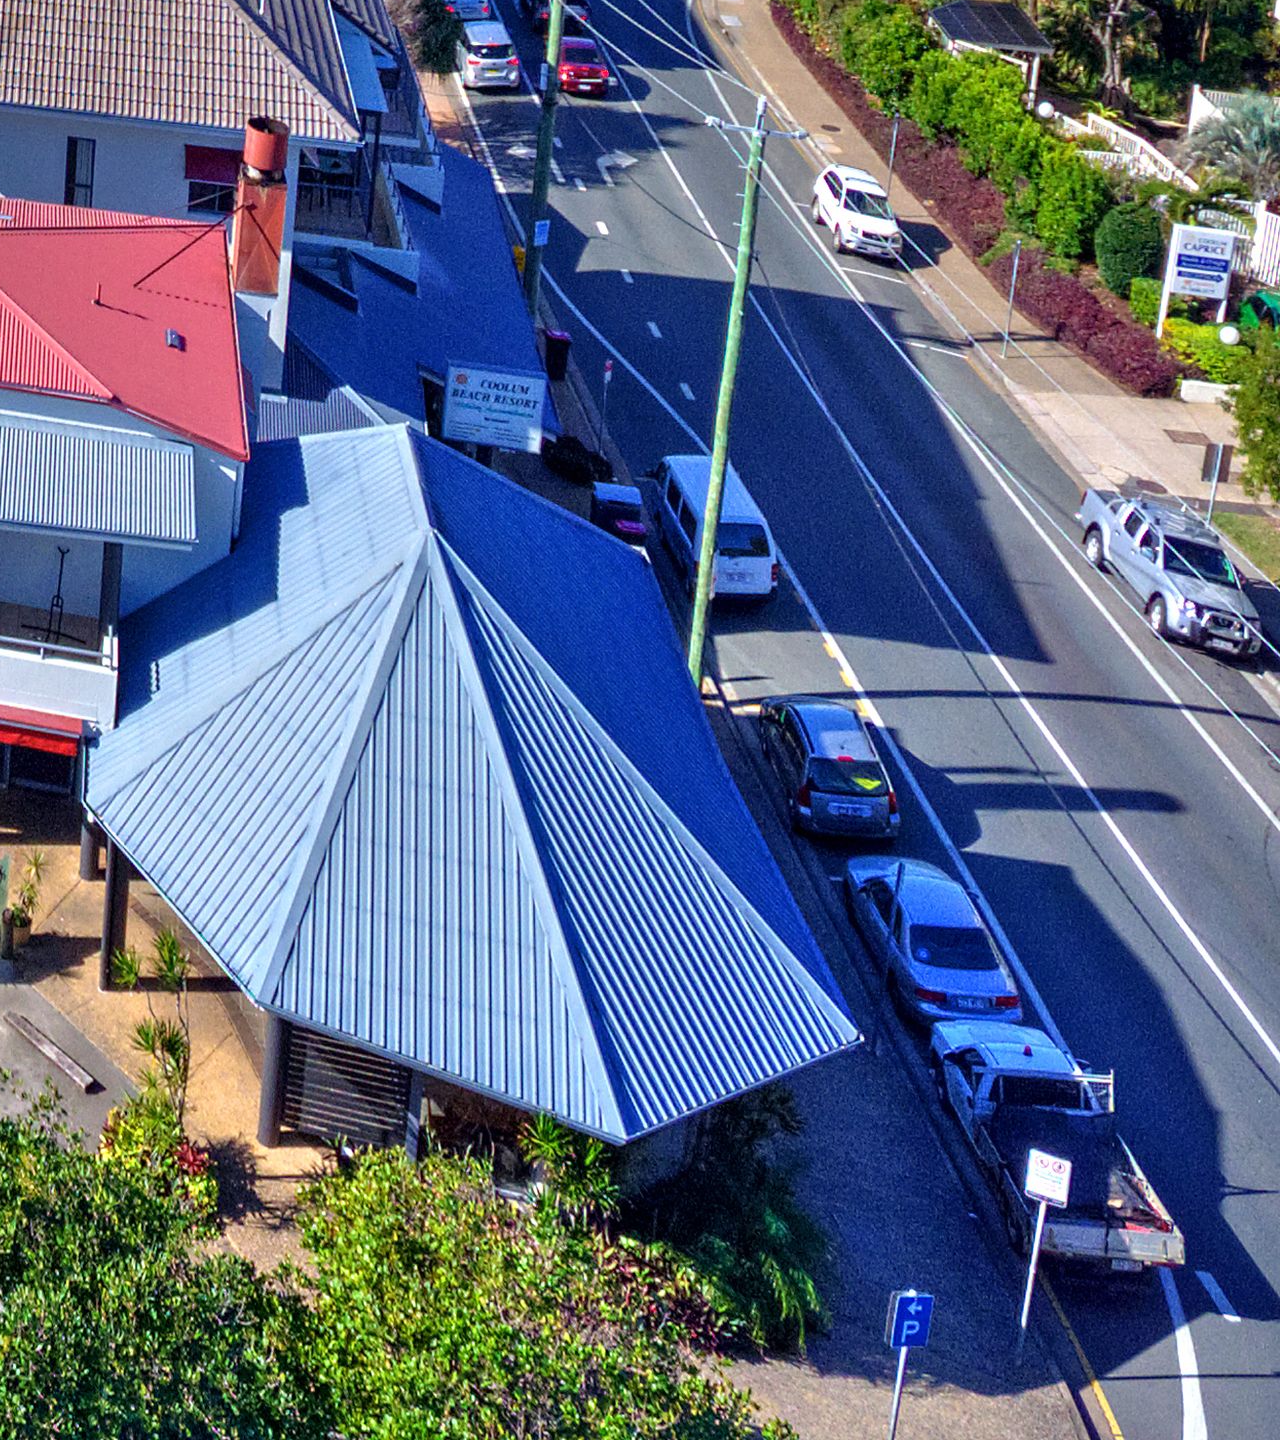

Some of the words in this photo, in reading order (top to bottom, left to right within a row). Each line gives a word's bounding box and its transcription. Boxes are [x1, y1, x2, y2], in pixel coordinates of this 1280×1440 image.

[1183, 242, 1226, 255] CAPRICE
[480, 379, 530, 395] COOLUM
[451, 388, 491, 402] BEACH
[493, 395, 540, 410] RESORT
[901, 1320, 921, 1343] P
